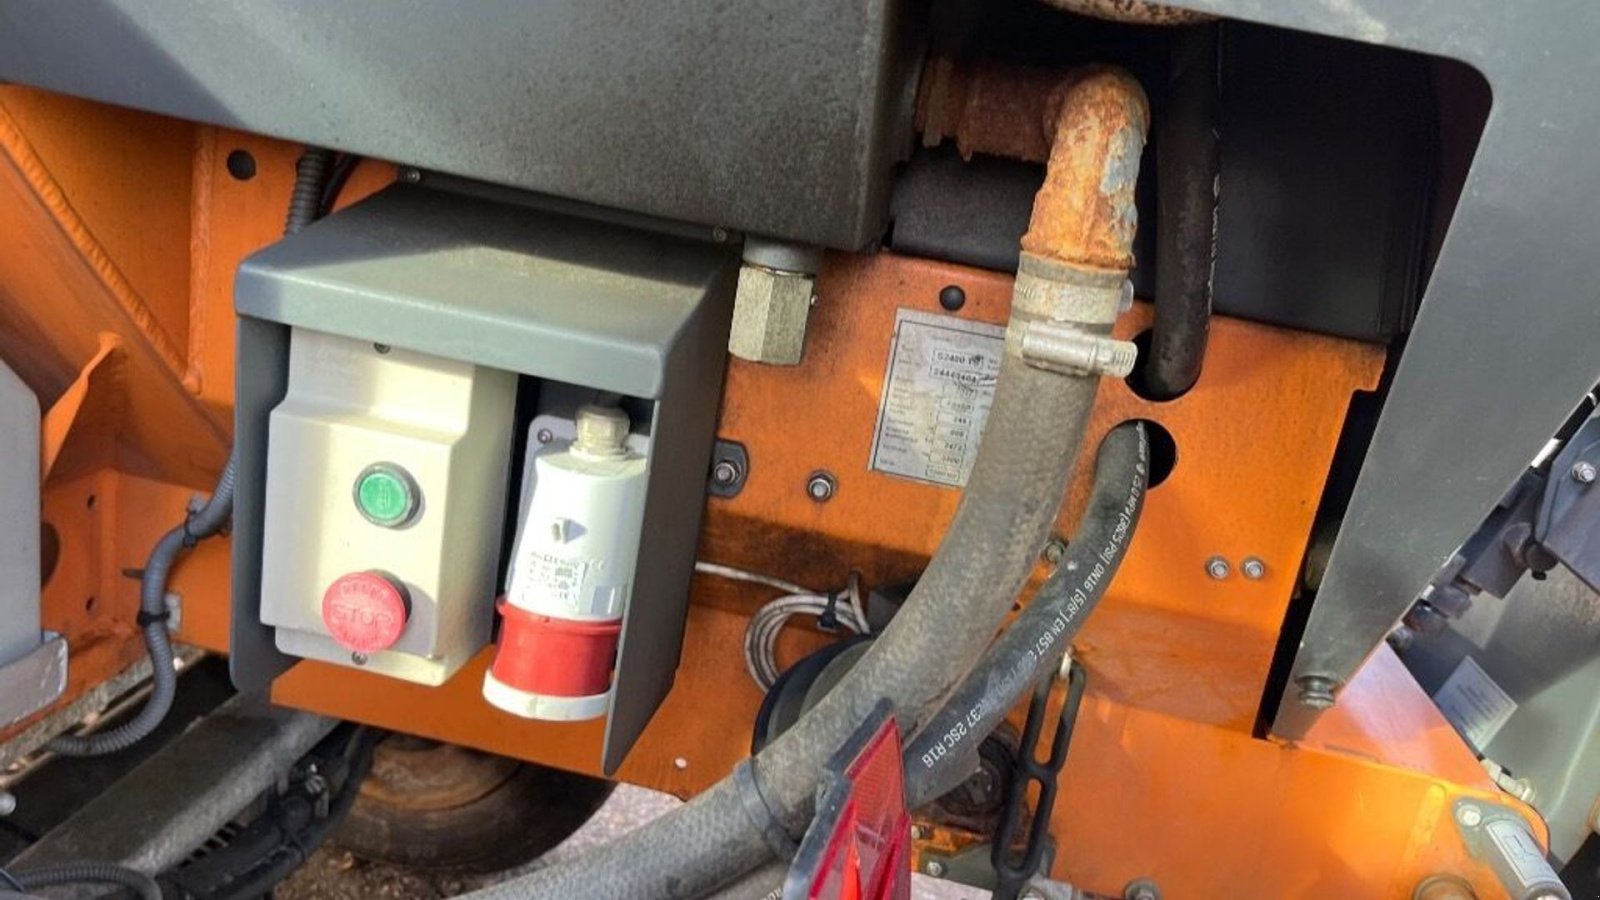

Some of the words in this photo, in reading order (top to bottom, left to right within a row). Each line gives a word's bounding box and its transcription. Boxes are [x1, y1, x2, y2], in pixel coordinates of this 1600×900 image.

[330, 603, 391, 630] STOP
[1049, 617, 1065, 635] EN
[1034, 631, 1053, 655] 857
[942, 721, 967, 747] 2SC
[920, 740, 947, 767] R16
